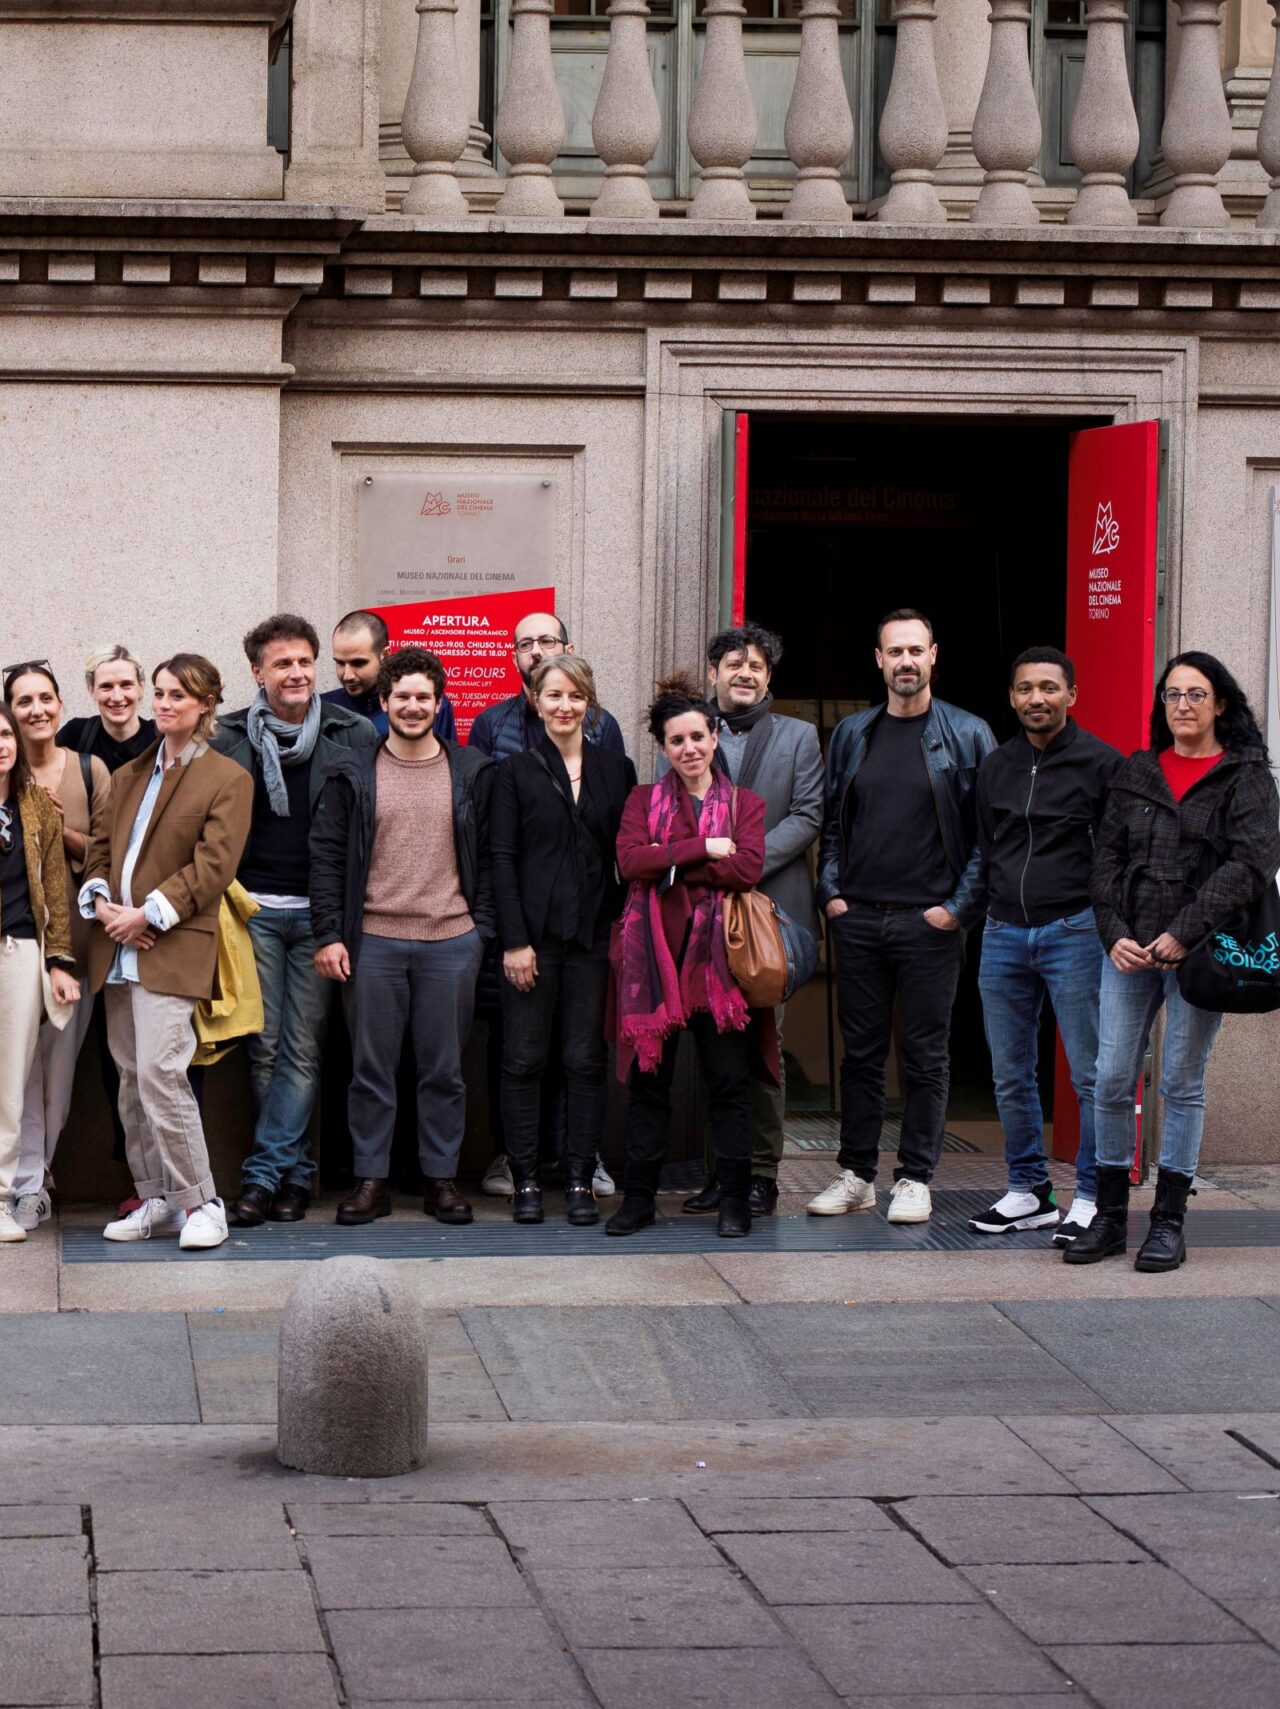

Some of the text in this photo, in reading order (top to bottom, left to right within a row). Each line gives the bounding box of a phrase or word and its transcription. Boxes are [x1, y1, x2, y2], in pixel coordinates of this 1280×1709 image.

[750, 487, 957, 511] nazionale del Cinema
[447, 556, 466, 564] Orari
[397, 572, 516, 581] MUSEO NAZIONALE DEL CINEMA
[1088, 568, 1109, 579] MUSEO
[1088, 580, 1122, 593] NAZIONALE
[1088, 594, 1122, 606] DEL CINEMA
[1088, 608, 1110, 620] TORINO
[422, 616, 490, 627] APERTURA
[400, 641, 428, 649] GIORNI
[467, 641, 496, 649] CHIUSO
[497, 641, 503, 649] IL
[434, 649, 471, 657] INGRESSO
[472, 649, 488, 657] ORE
[489, 649, 507, 657] 18.00
[464, 667, 507, 678] HOURS
